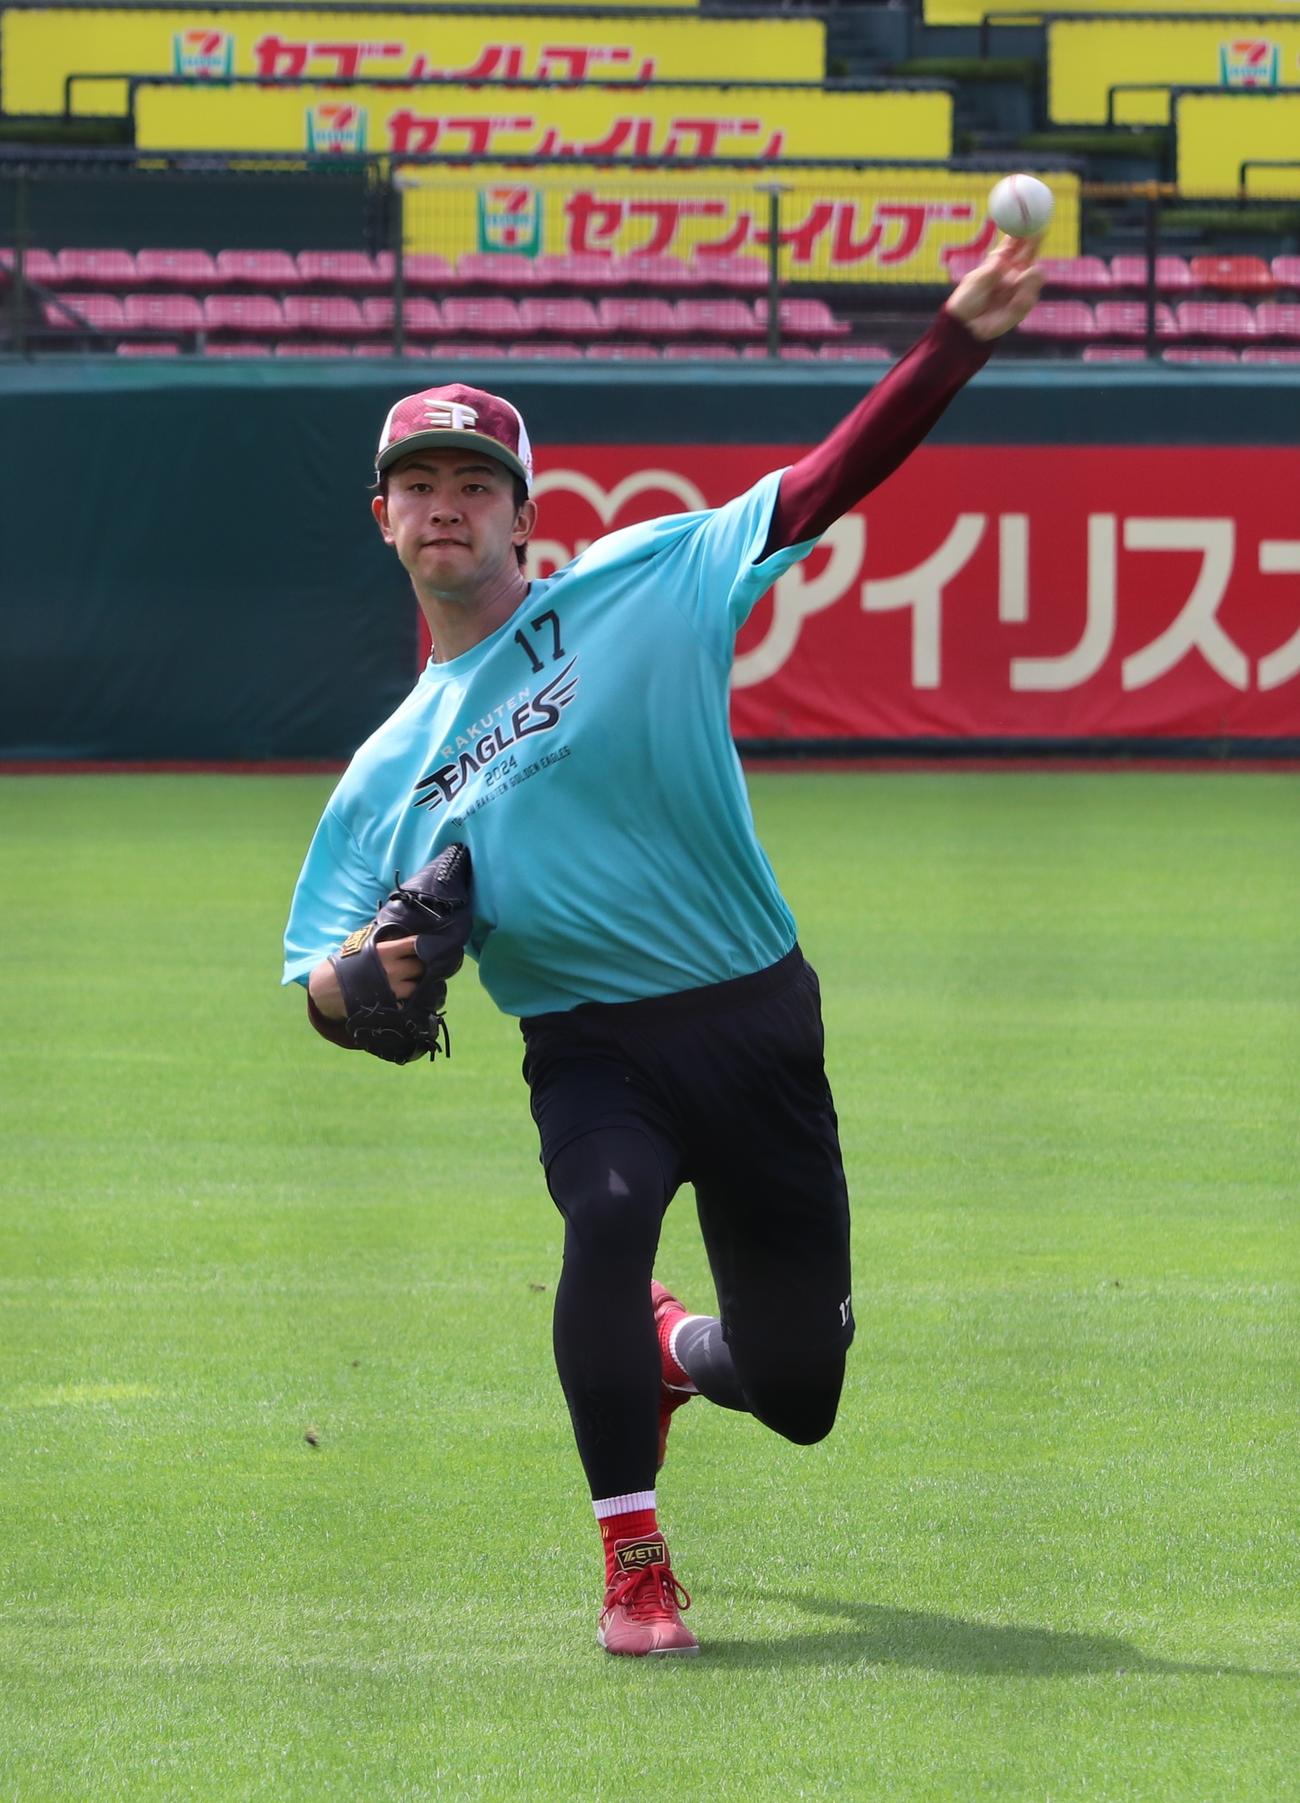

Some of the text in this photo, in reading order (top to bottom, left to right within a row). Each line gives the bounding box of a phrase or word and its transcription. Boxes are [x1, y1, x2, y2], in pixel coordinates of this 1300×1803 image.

[514, 608, 566, 674] 17
[412, 655, 580, 811] EAGLES
[441, 687, 531, 759] RAKUTEN
[484, 754, 518, 787] 2024
[540, 745, 572, 769] EAGLES
[622, 1545, 663, 1563] ZETT
